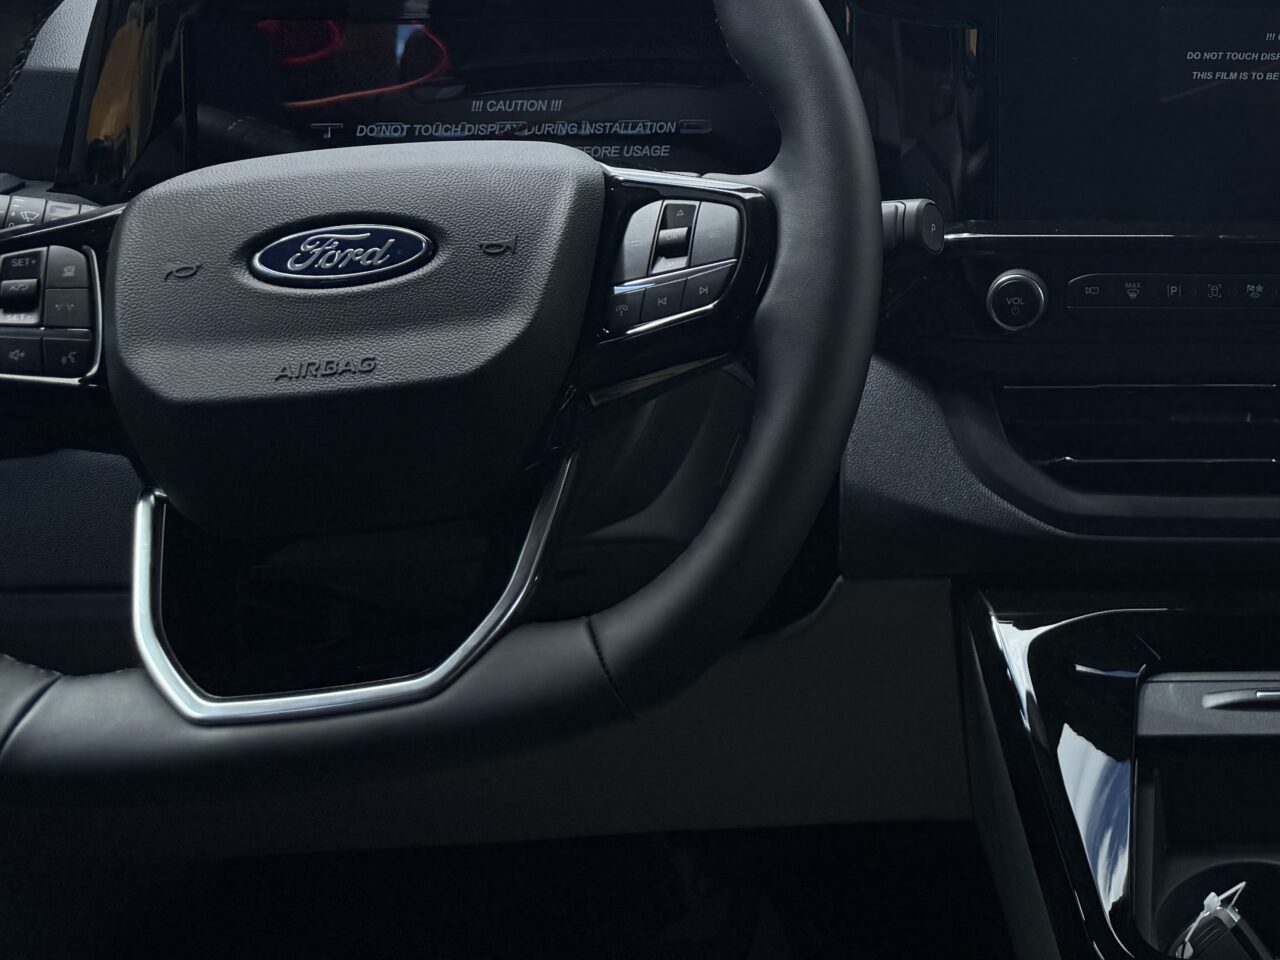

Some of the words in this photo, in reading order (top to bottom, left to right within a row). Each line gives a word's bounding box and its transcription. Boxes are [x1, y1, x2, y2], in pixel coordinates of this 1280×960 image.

[1187, 51, 1202, 60] DO
[1203, 52, 1225, 61] NOT
[1226, 52, 1259, 61] TOUCH
[1191, 71, 1213, 80] THIS
[1215, 71, 1239, 81] FILM
[1239, 72, 1249, 81] IS
[1251, 72, 1264, 81] TO
[1266, 72, 1280, 81] BE
[486, 100, 548, 112] CAUTION
[356, 125, 376, 137] DO
[380, 124, 410, 136] NOT
[414, 124, 462, 136] TOUCH
[582, 122, 677, 135] INSTALLATION
[577, 145, 621, 158] FORE
[623, 145, 671, 157] USAGE
[286, 232, 396, 271] Ford
[1006, 297, 1025, 305] VOL
[274, 356, 377, 381] AIRBAG
